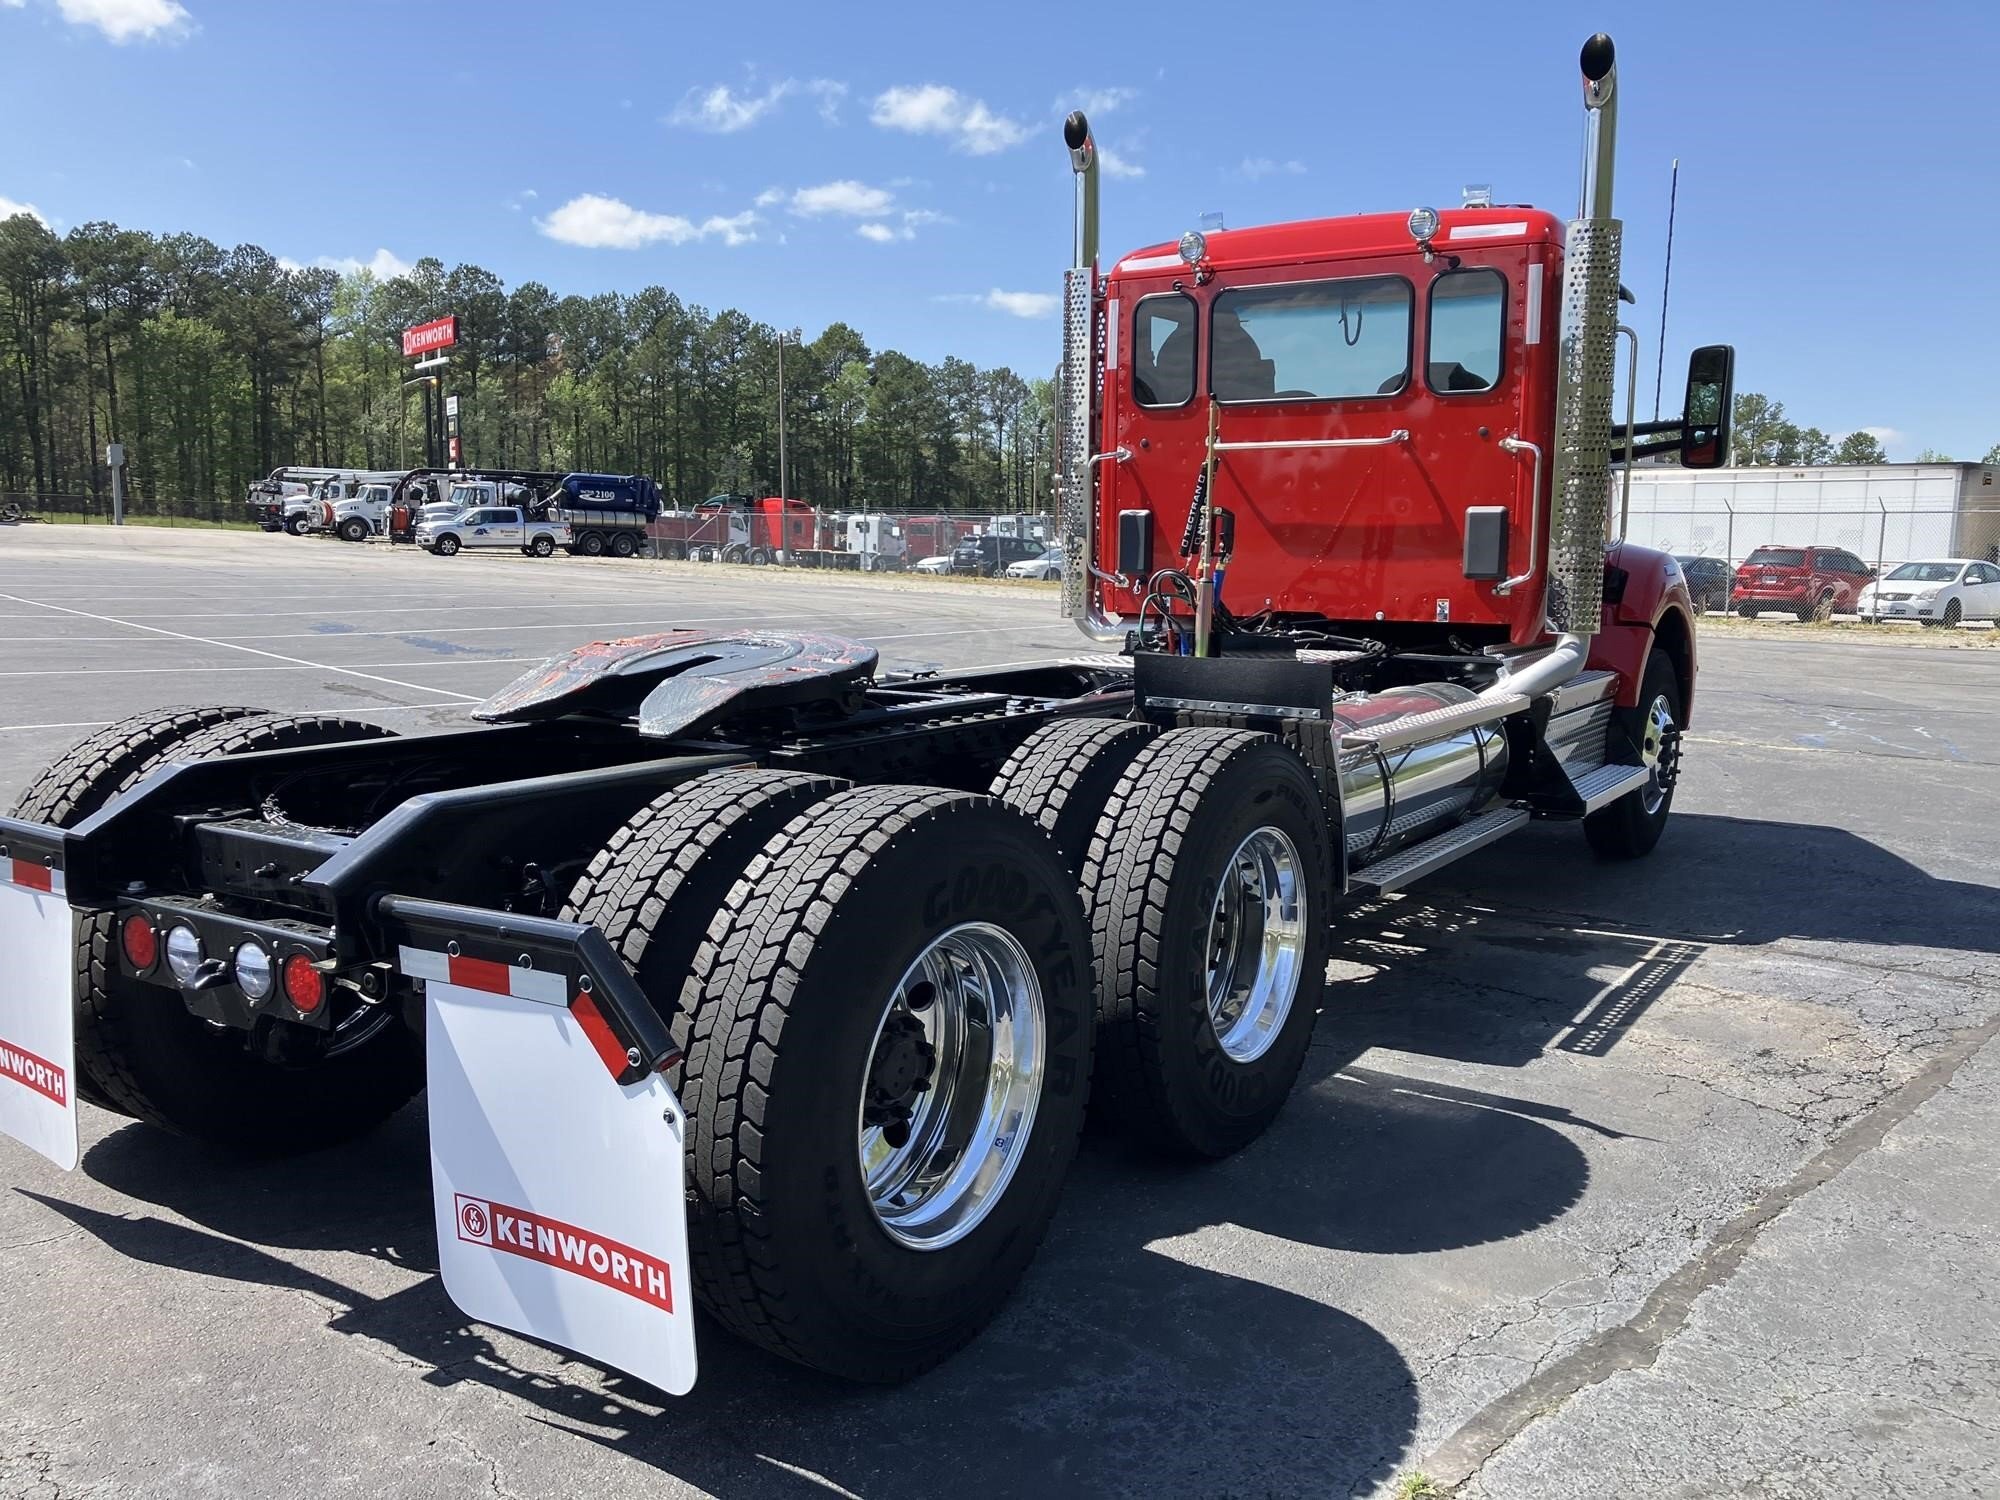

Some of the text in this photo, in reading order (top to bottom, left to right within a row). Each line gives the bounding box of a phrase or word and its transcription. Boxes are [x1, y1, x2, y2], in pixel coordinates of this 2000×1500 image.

[411, 323, 452, 348] KENWORTH
[595, 490, 615, 499] 2100
[1184, 485, 1202, 536] TECTRAN
[923, 863, 1079, 1097] GOODYEAR
[0, 1046, 64, 1098] NWORTH
[496, 1213, 667, 1300] KENWORTH
